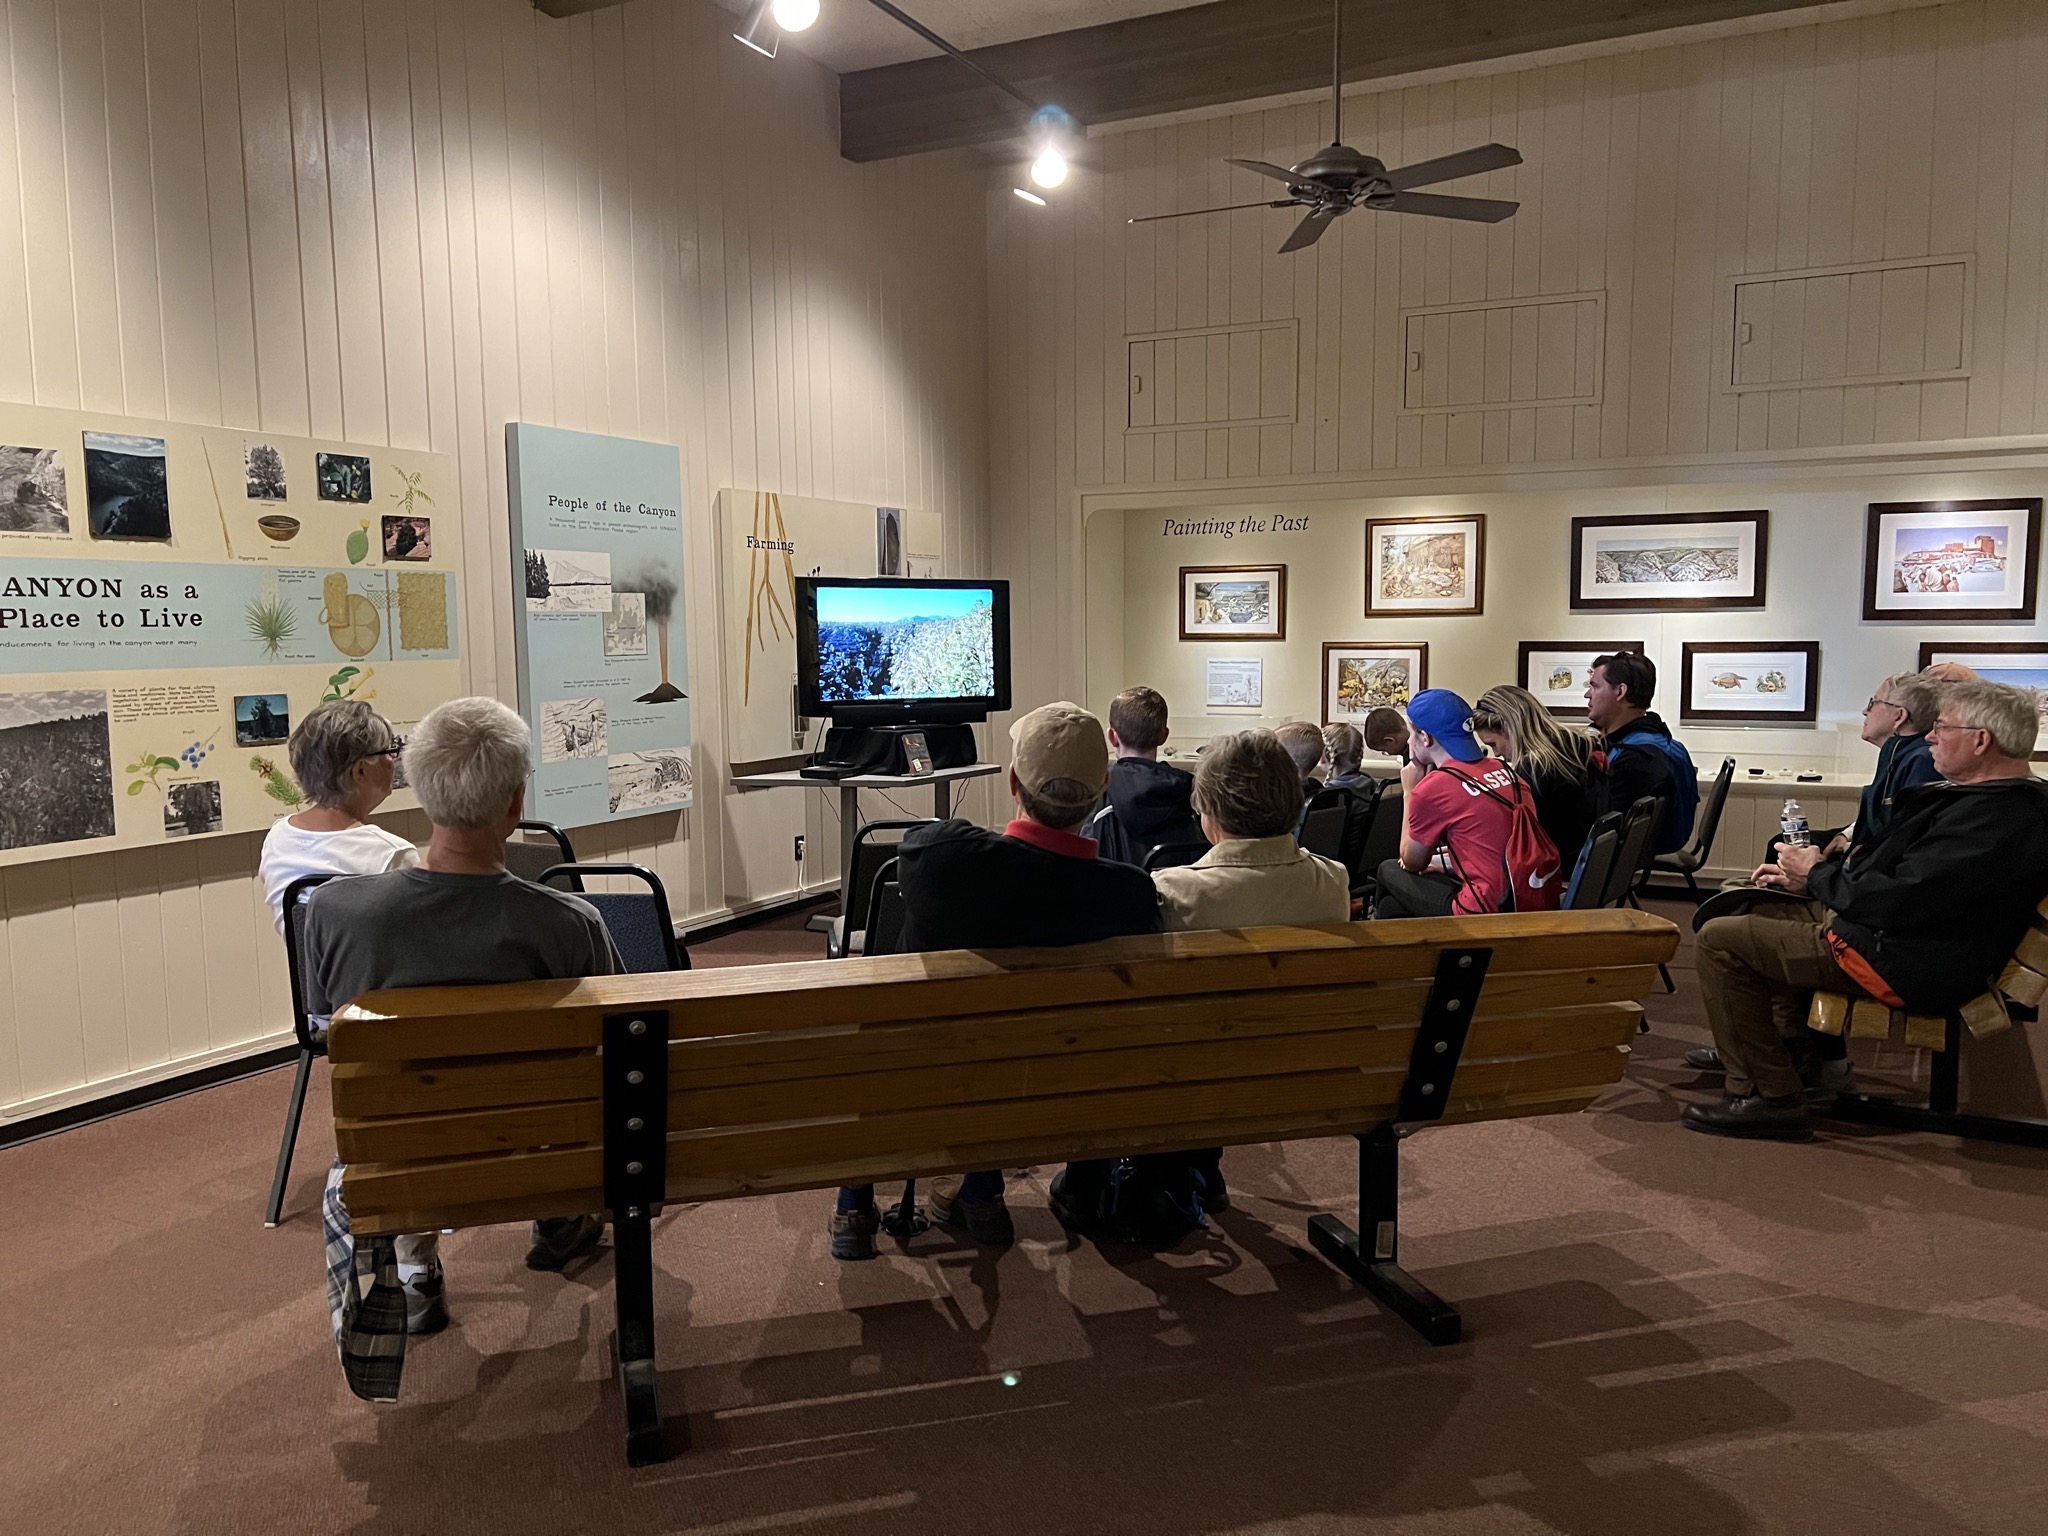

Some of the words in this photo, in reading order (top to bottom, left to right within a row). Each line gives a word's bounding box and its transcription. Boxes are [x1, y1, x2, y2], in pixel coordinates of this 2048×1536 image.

[548, 495, 588, 512] People
[596, 500, 607, 511] of
[614, 502, 631, 513] the
[638, 503, 676, 519] Canyon
[1162, 518, 1236, 539] Painting
[1239, 516, 1266, 532] the
[1271, 514, 1309, 532] Past
[746, 536, 794, 554] Farming
[0, 576, 122, 598] ANYON
[140, 583, 169, 598] as
[184, 584, 199, 599] a
[0, 608, 80, 628] Place
[97, 609, 124, 628] to
[140, 608, 203, 628] Live
[73, 640, 95, 648] living
